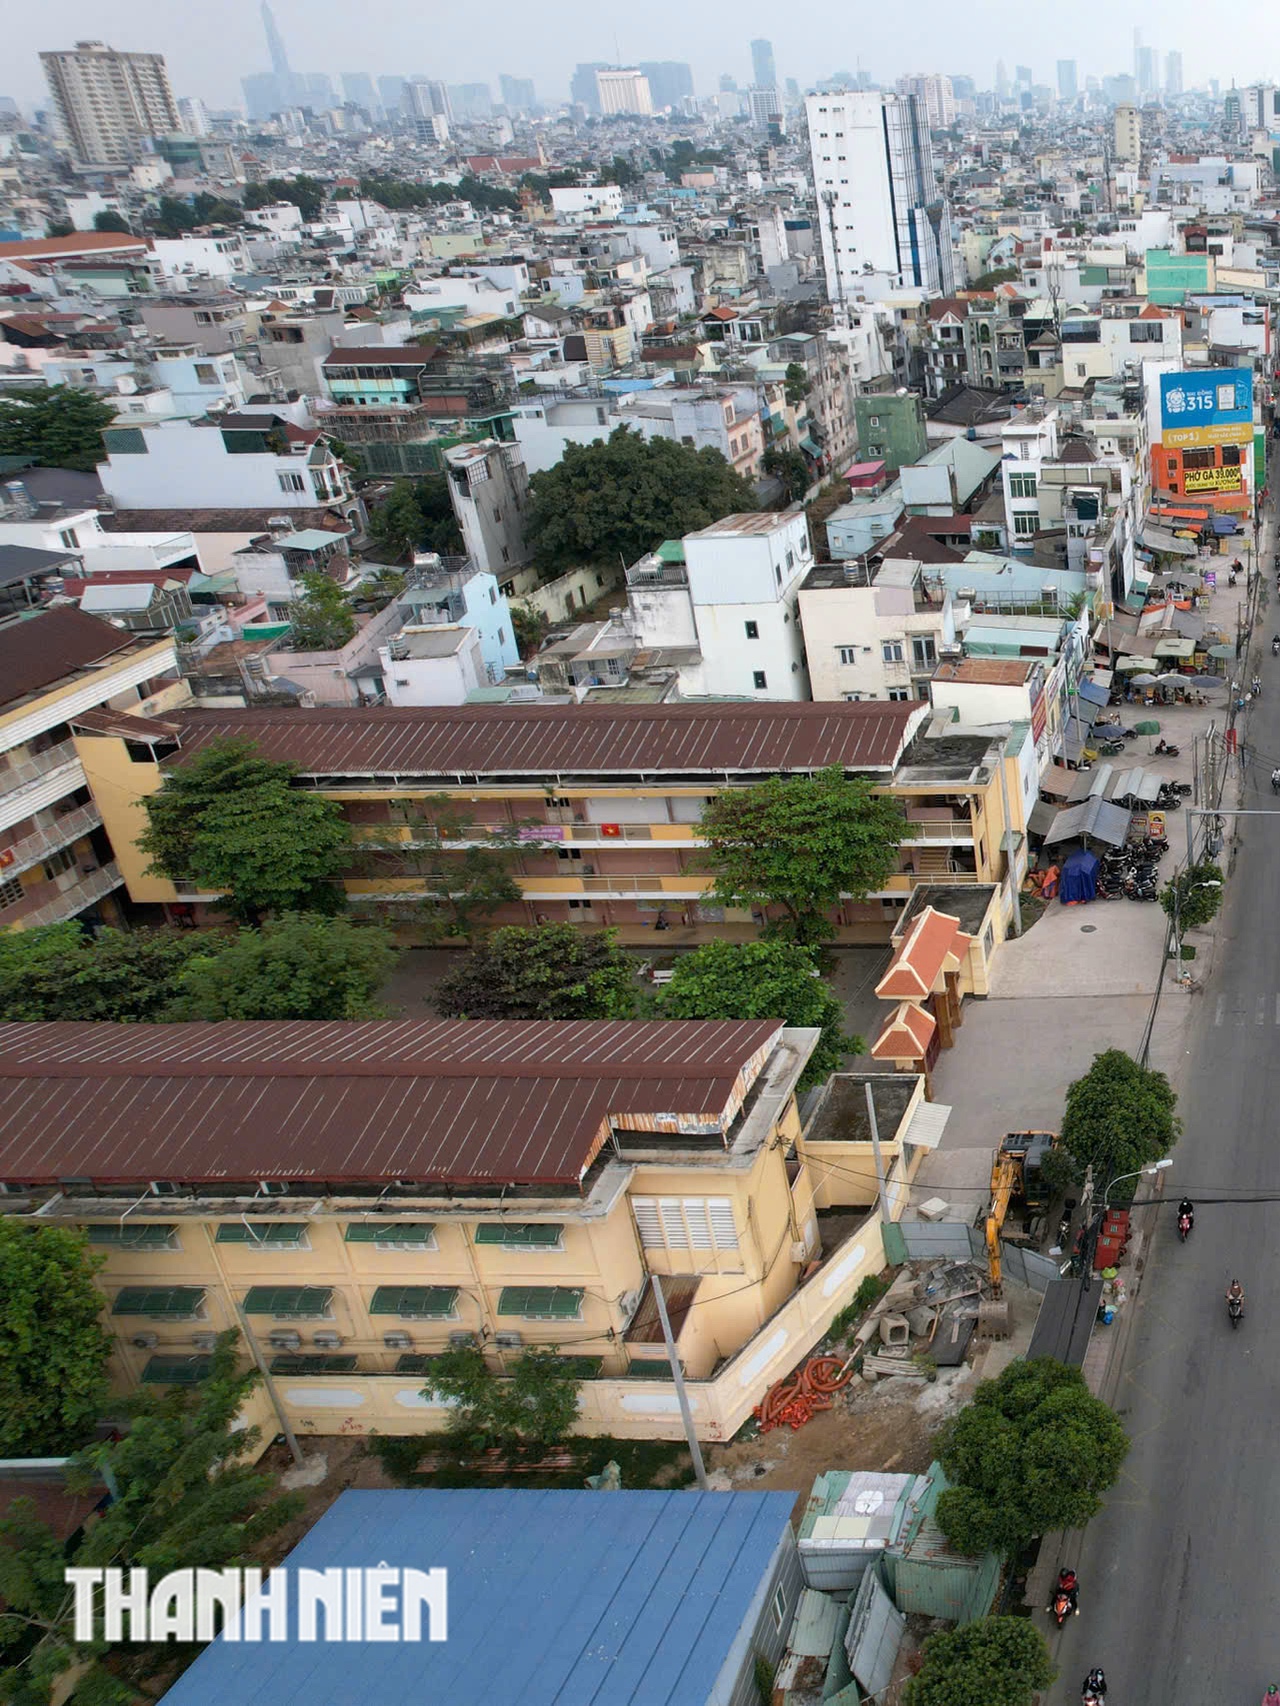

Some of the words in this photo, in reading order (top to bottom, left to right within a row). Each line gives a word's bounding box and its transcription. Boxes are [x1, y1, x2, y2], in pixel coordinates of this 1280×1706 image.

[1187, 396, 1213, 411] 315
[1184, 470, 1201, 482] PHỞ
[1202, 469, 1214, 480] GÀ
